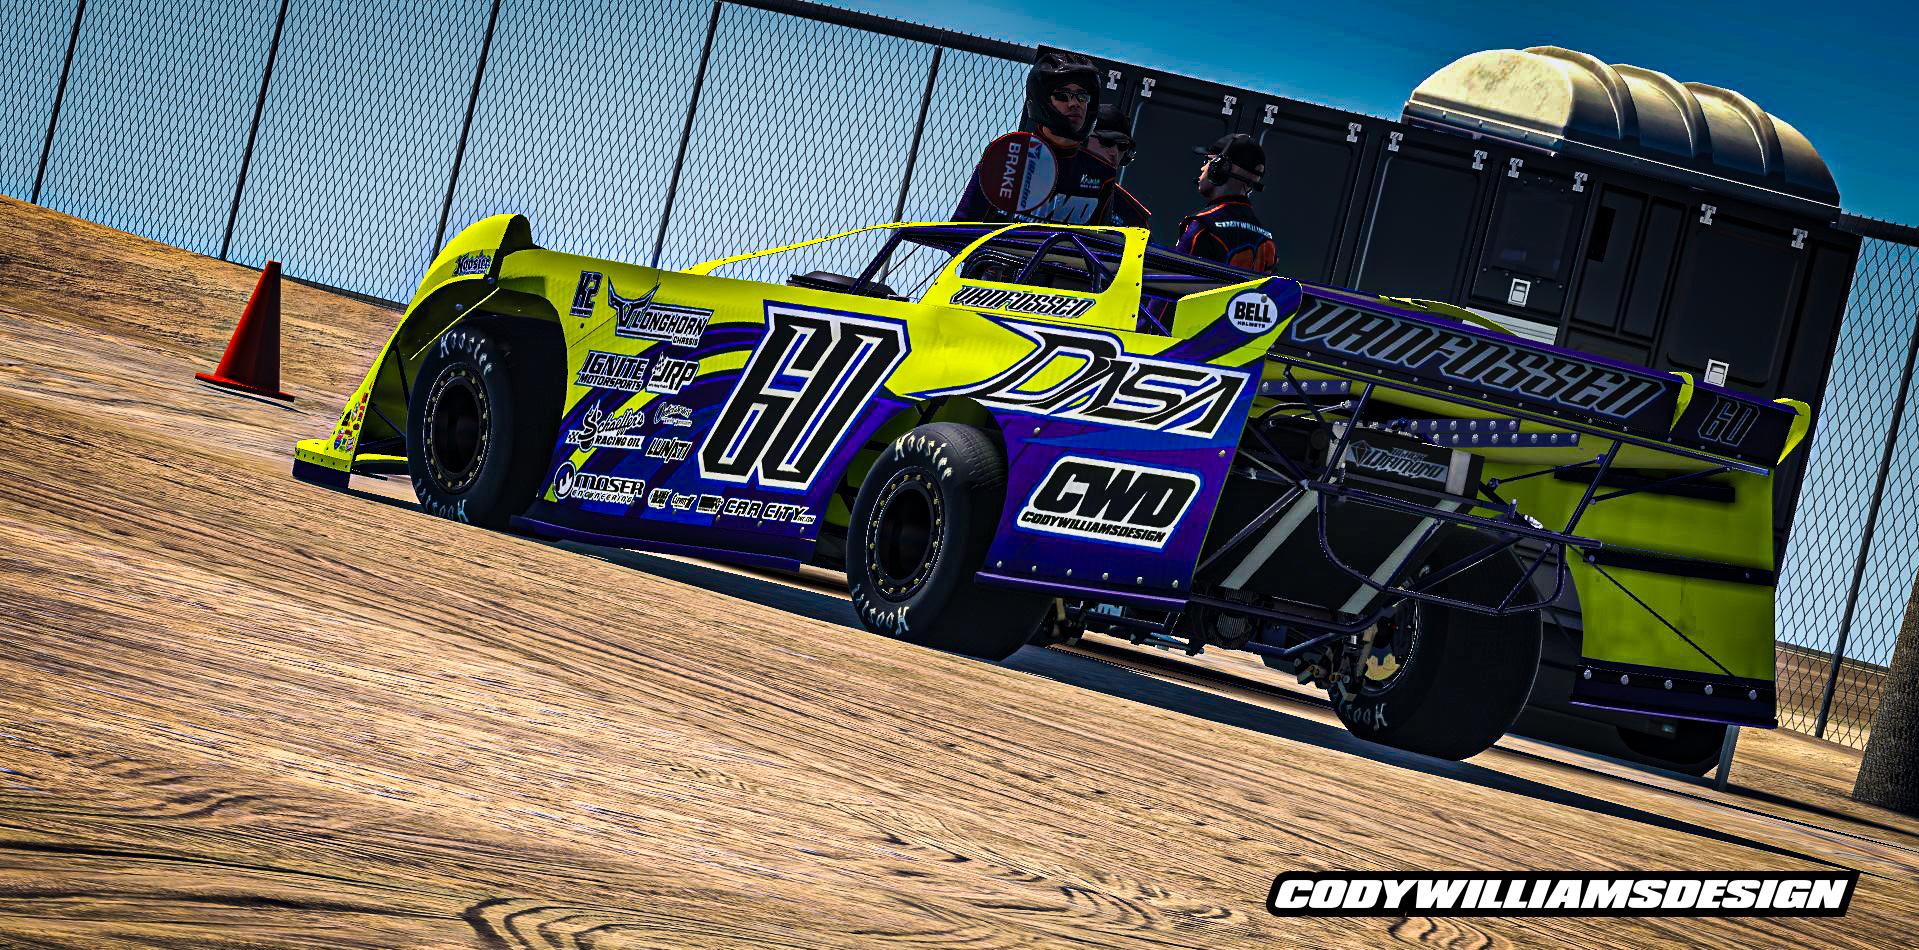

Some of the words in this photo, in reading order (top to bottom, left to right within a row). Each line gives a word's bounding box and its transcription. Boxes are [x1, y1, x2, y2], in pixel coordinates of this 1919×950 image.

[999, 142, 1022, 199] BRAKE
[950, 285, 1097, 319] VANFOSSEN
[1234, 301, 1271, 323] BELL
[629, 309, 706, 339] LONGHORN
[672, 336, 700, 347] CHASSIS
[582, 353, 648, 380] IGNITE
[651, 358, 699, 391] JRP
[1291, 300, 1667, 418] VANFOSSEN
[579, 373, 643, 391] MOTORSPORTS
[970, 325, 1250, 438] DASA
[698, 306, 907, 490] 60
[1698, 397, 1760, 448] 60
[595, 435, 627, 447] RACING
[627, 437, 641, 448] OIL
[574, 473, 645, 497] MOSER
[1032, 460, 1199, 528] CWD
[724, 500, 762, 518] CAR
[763, 504, 808, 522] CITY
[1021, 511, 1167, 543] CODYWILLIAMSDESIGN
